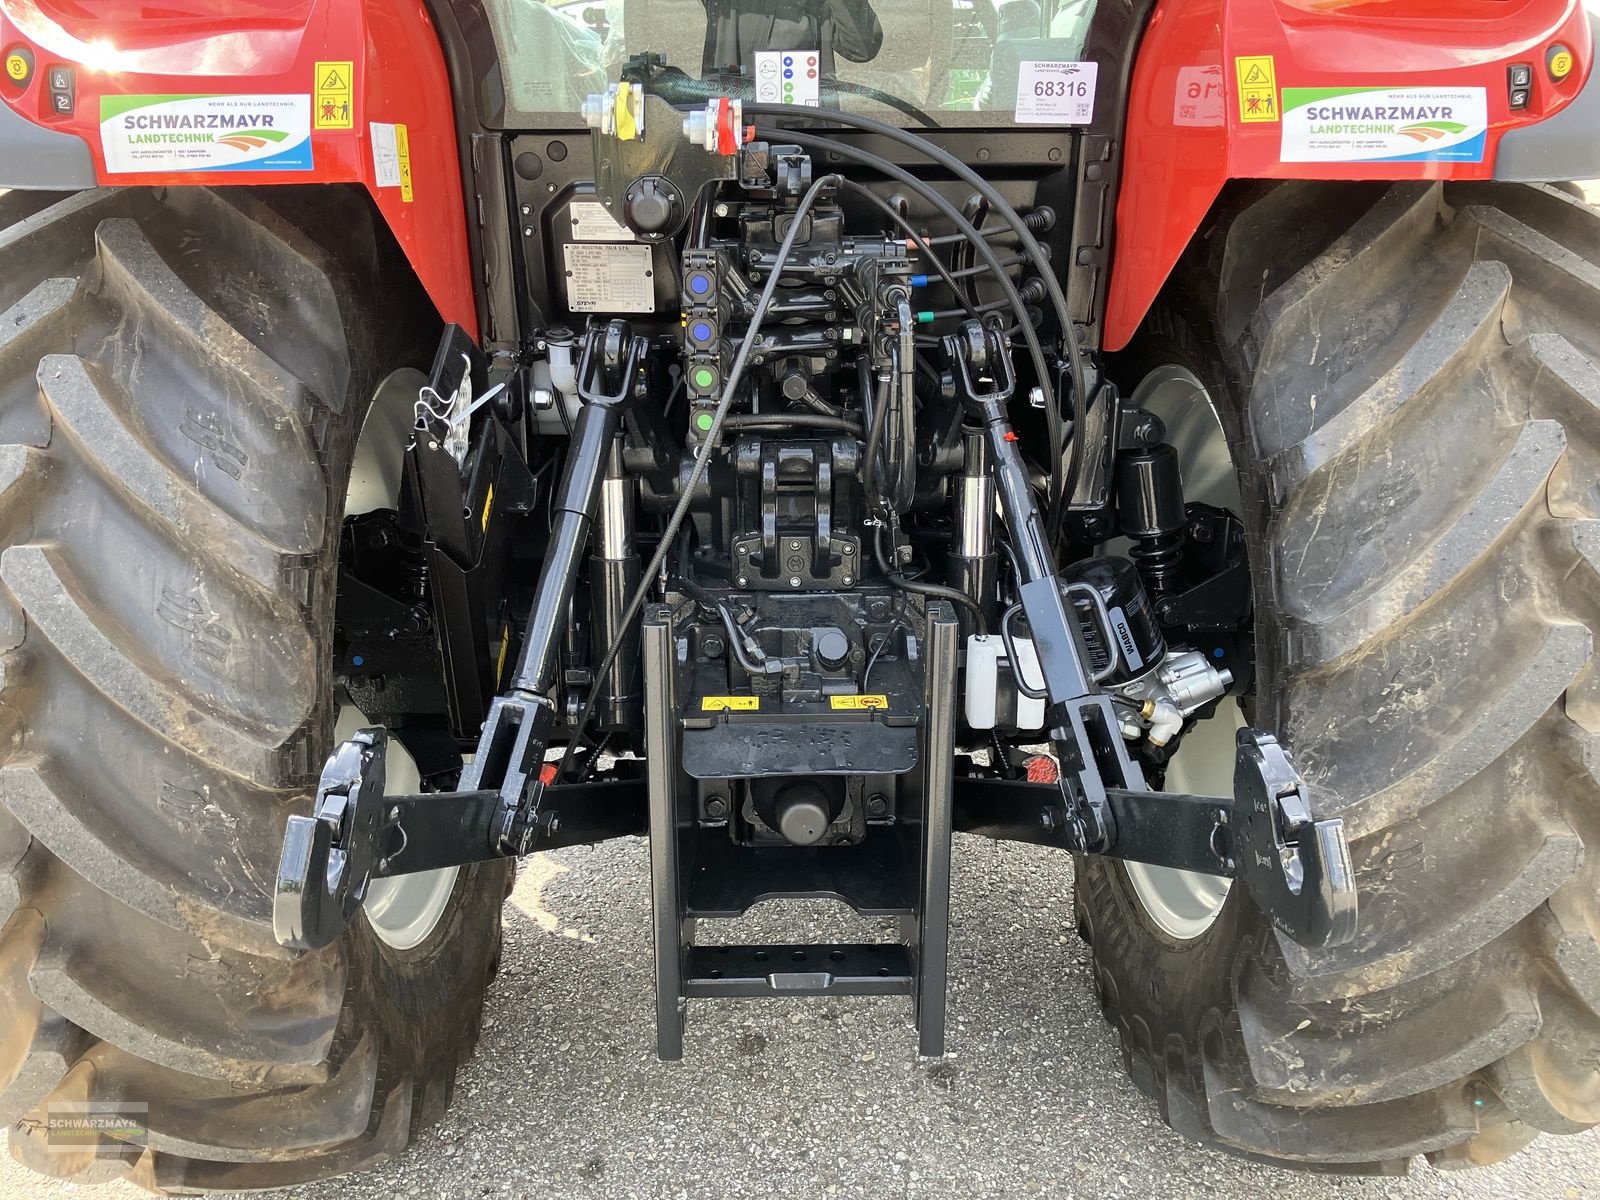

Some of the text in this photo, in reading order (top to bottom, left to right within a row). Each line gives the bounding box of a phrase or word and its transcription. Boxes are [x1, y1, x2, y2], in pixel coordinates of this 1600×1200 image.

[1034, 81, 1087, 97] 68316
[1306, 106, 1453, 121] SCHWARZMAYR
[124, 114, 274, 130] SCHWARZMAYR
[1310, 124, 1396, 135] LANDTECHNIK
[127, 132, 215, 144] LANDTECHNIK
[1117, 622, 1135, 655] WABCO
